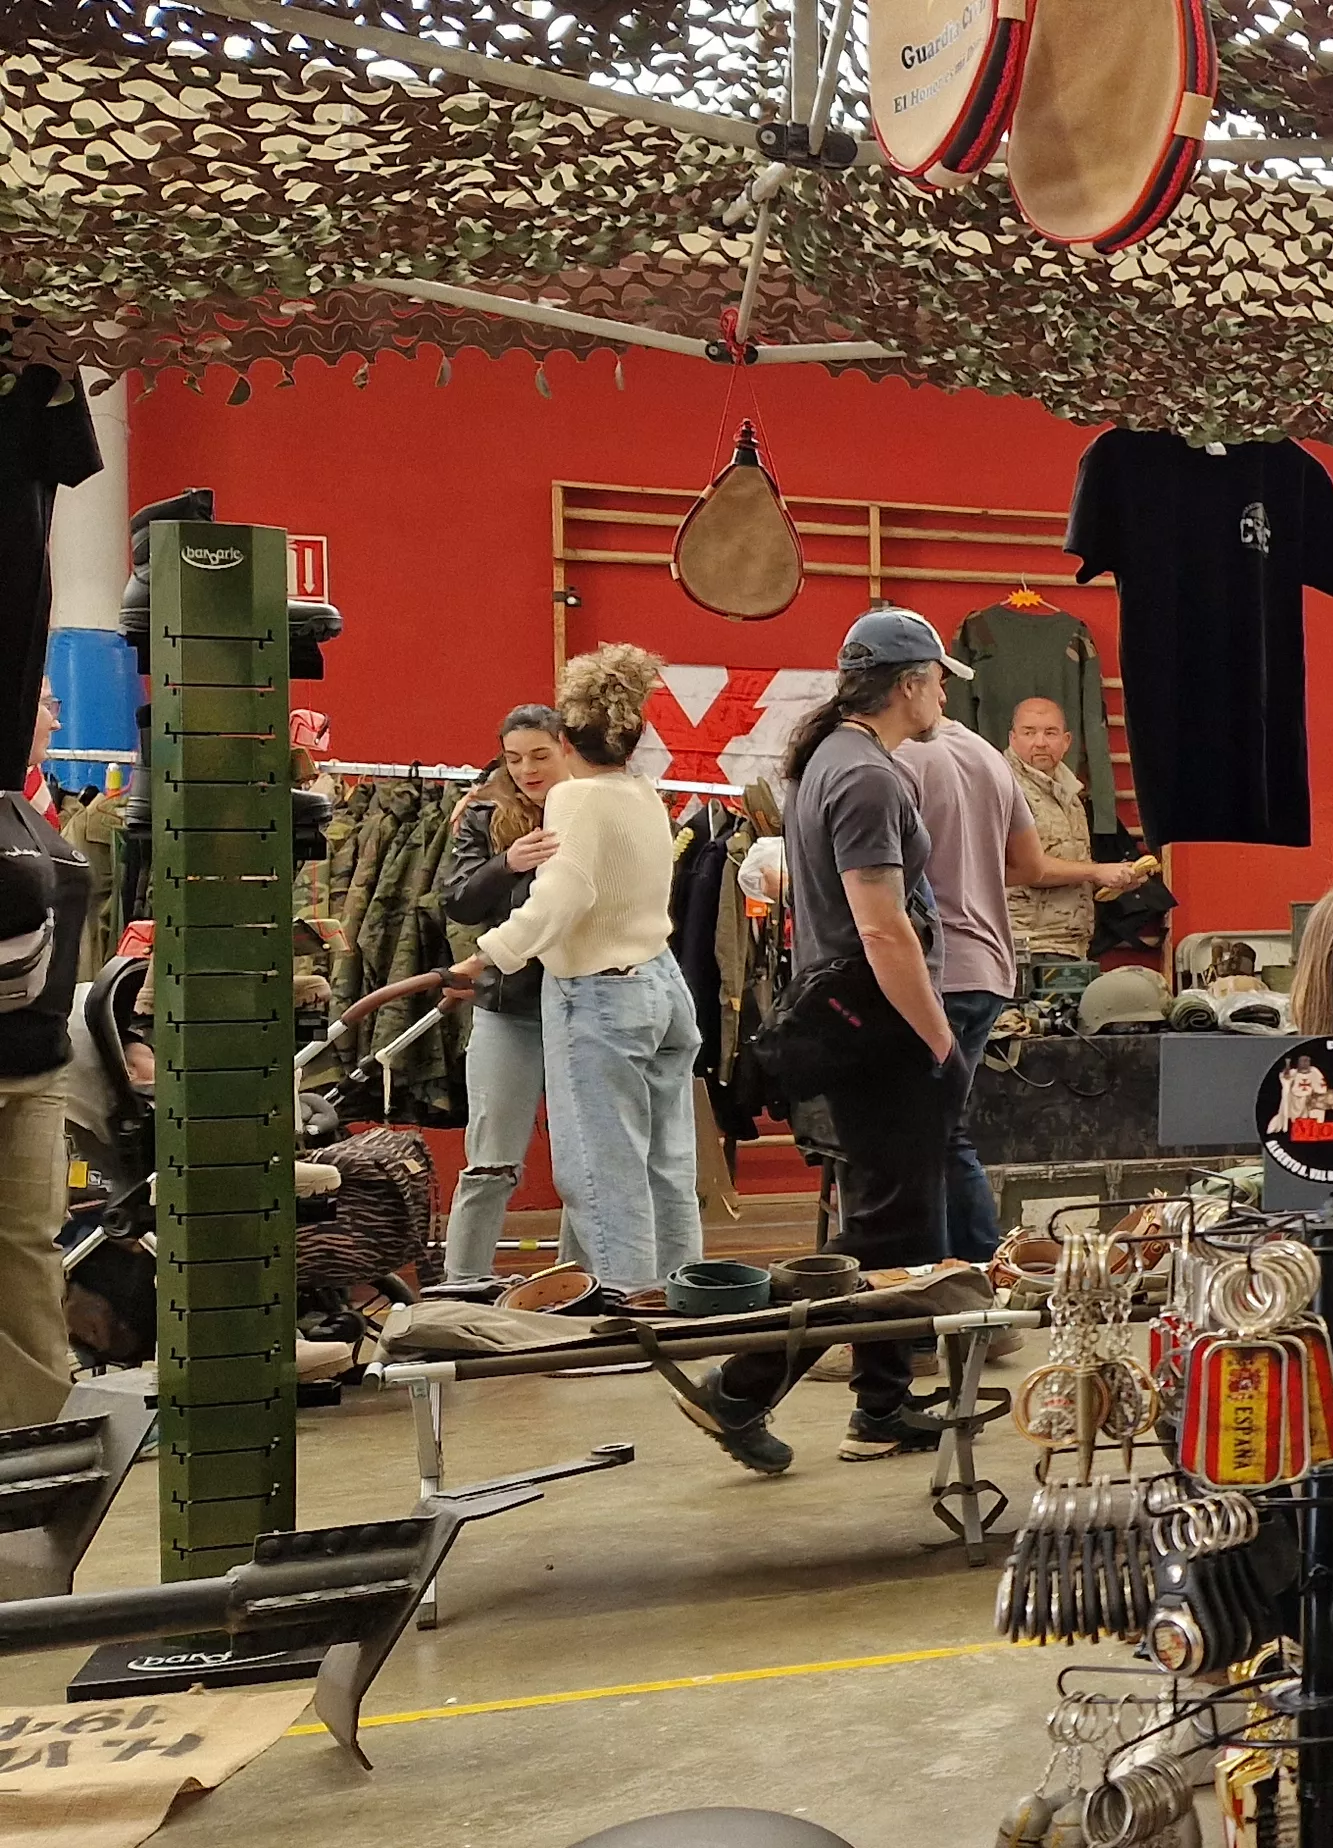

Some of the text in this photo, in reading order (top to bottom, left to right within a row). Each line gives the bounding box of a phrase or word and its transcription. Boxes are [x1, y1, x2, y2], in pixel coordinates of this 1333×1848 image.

[900, 18, 961, 70] Guardia
[893, 94, 908, 114] El
[1233, 1406, 1256, 1471] ESPAÑA
